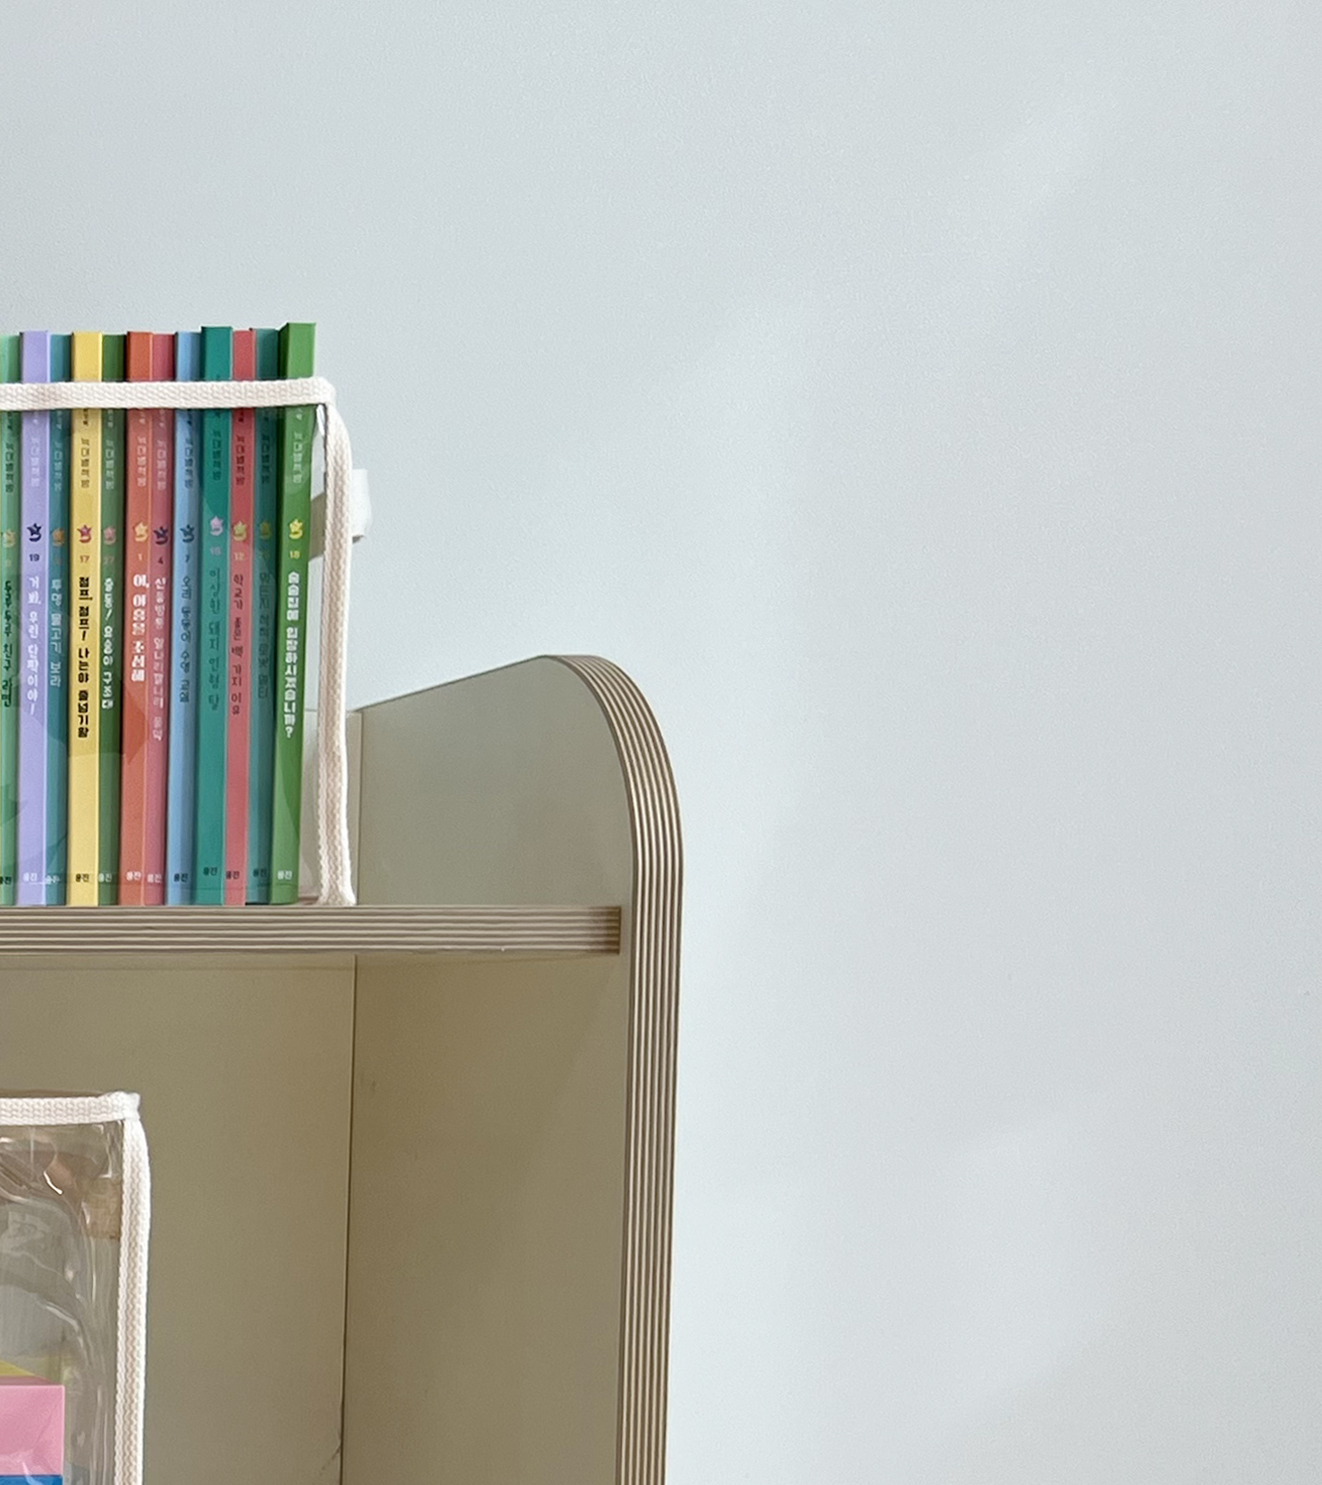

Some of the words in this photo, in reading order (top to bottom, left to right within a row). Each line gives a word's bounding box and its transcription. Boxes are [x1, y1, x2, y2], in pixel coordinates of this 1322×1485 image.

[29, 554, 40, 562] 19
[79, 555, 90, 563] 17
[203, 866, 218, 877] 웅진
[277, 870, 292, 881] 웅진
[75, 873, 90, 883] 웅진
[173, 872, 188, 883] 웅진
